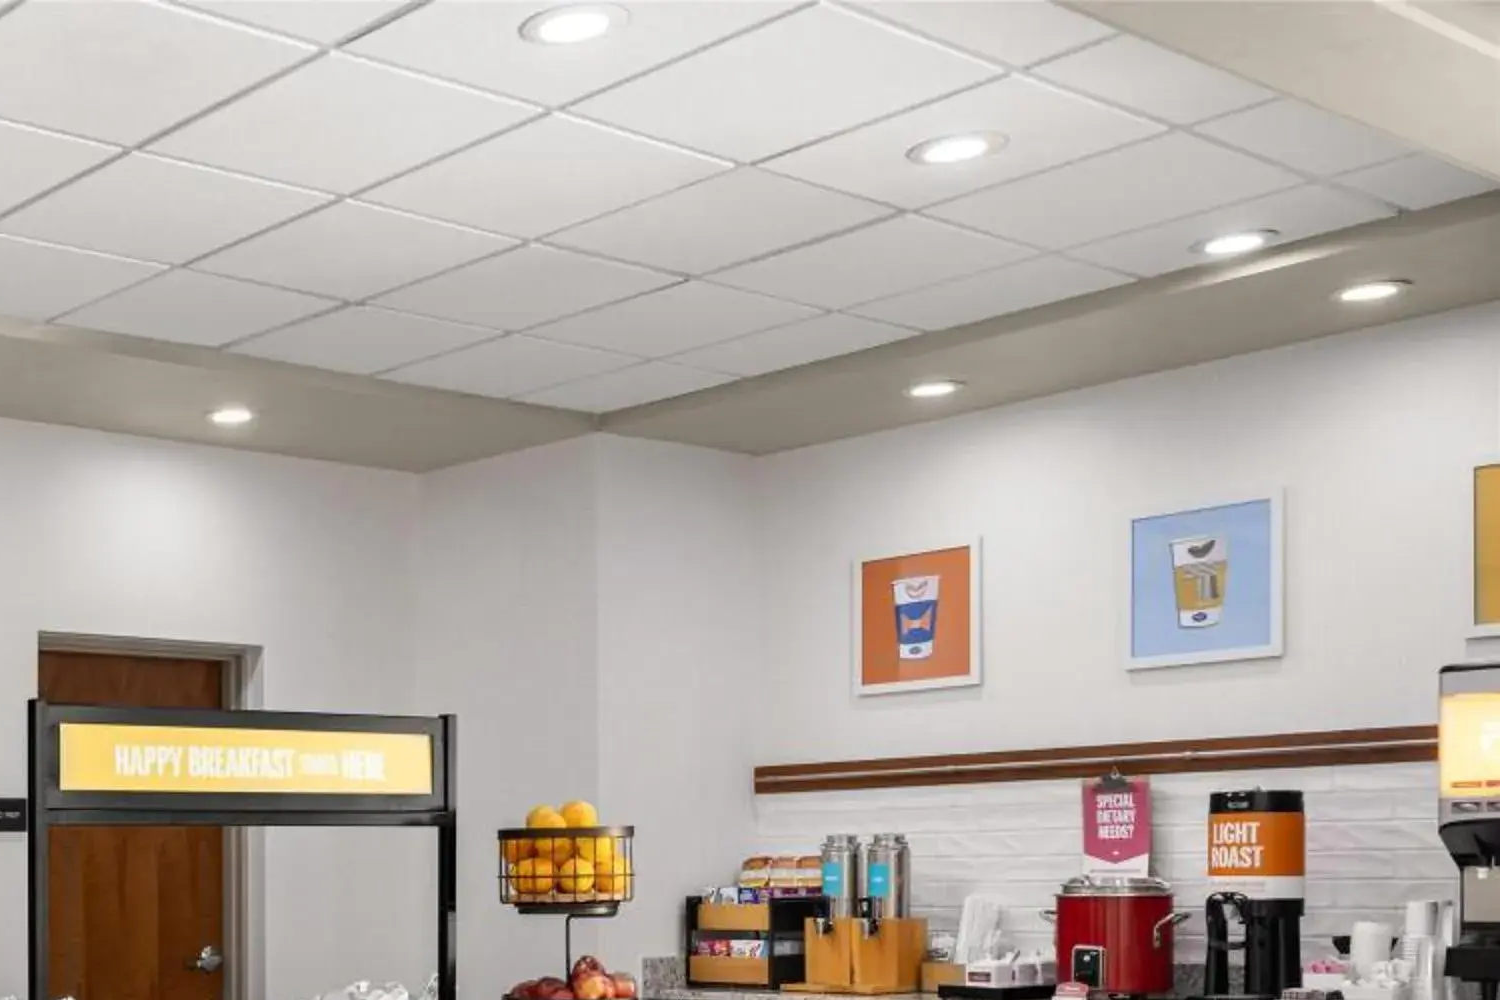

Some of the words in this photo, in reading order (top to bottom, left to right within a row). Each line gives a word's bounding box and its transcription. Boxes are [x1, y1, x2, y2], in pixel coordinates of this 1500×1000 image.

[114, 745, 183, 777] HAPPY
[188, 745, 296, 779] BREAKFAST
[1096, 793, 1135, 809] SPECIAL
[1212, 821, 1260, 845] LIGHT
[1211, 845, 1264, 869] ROAST
